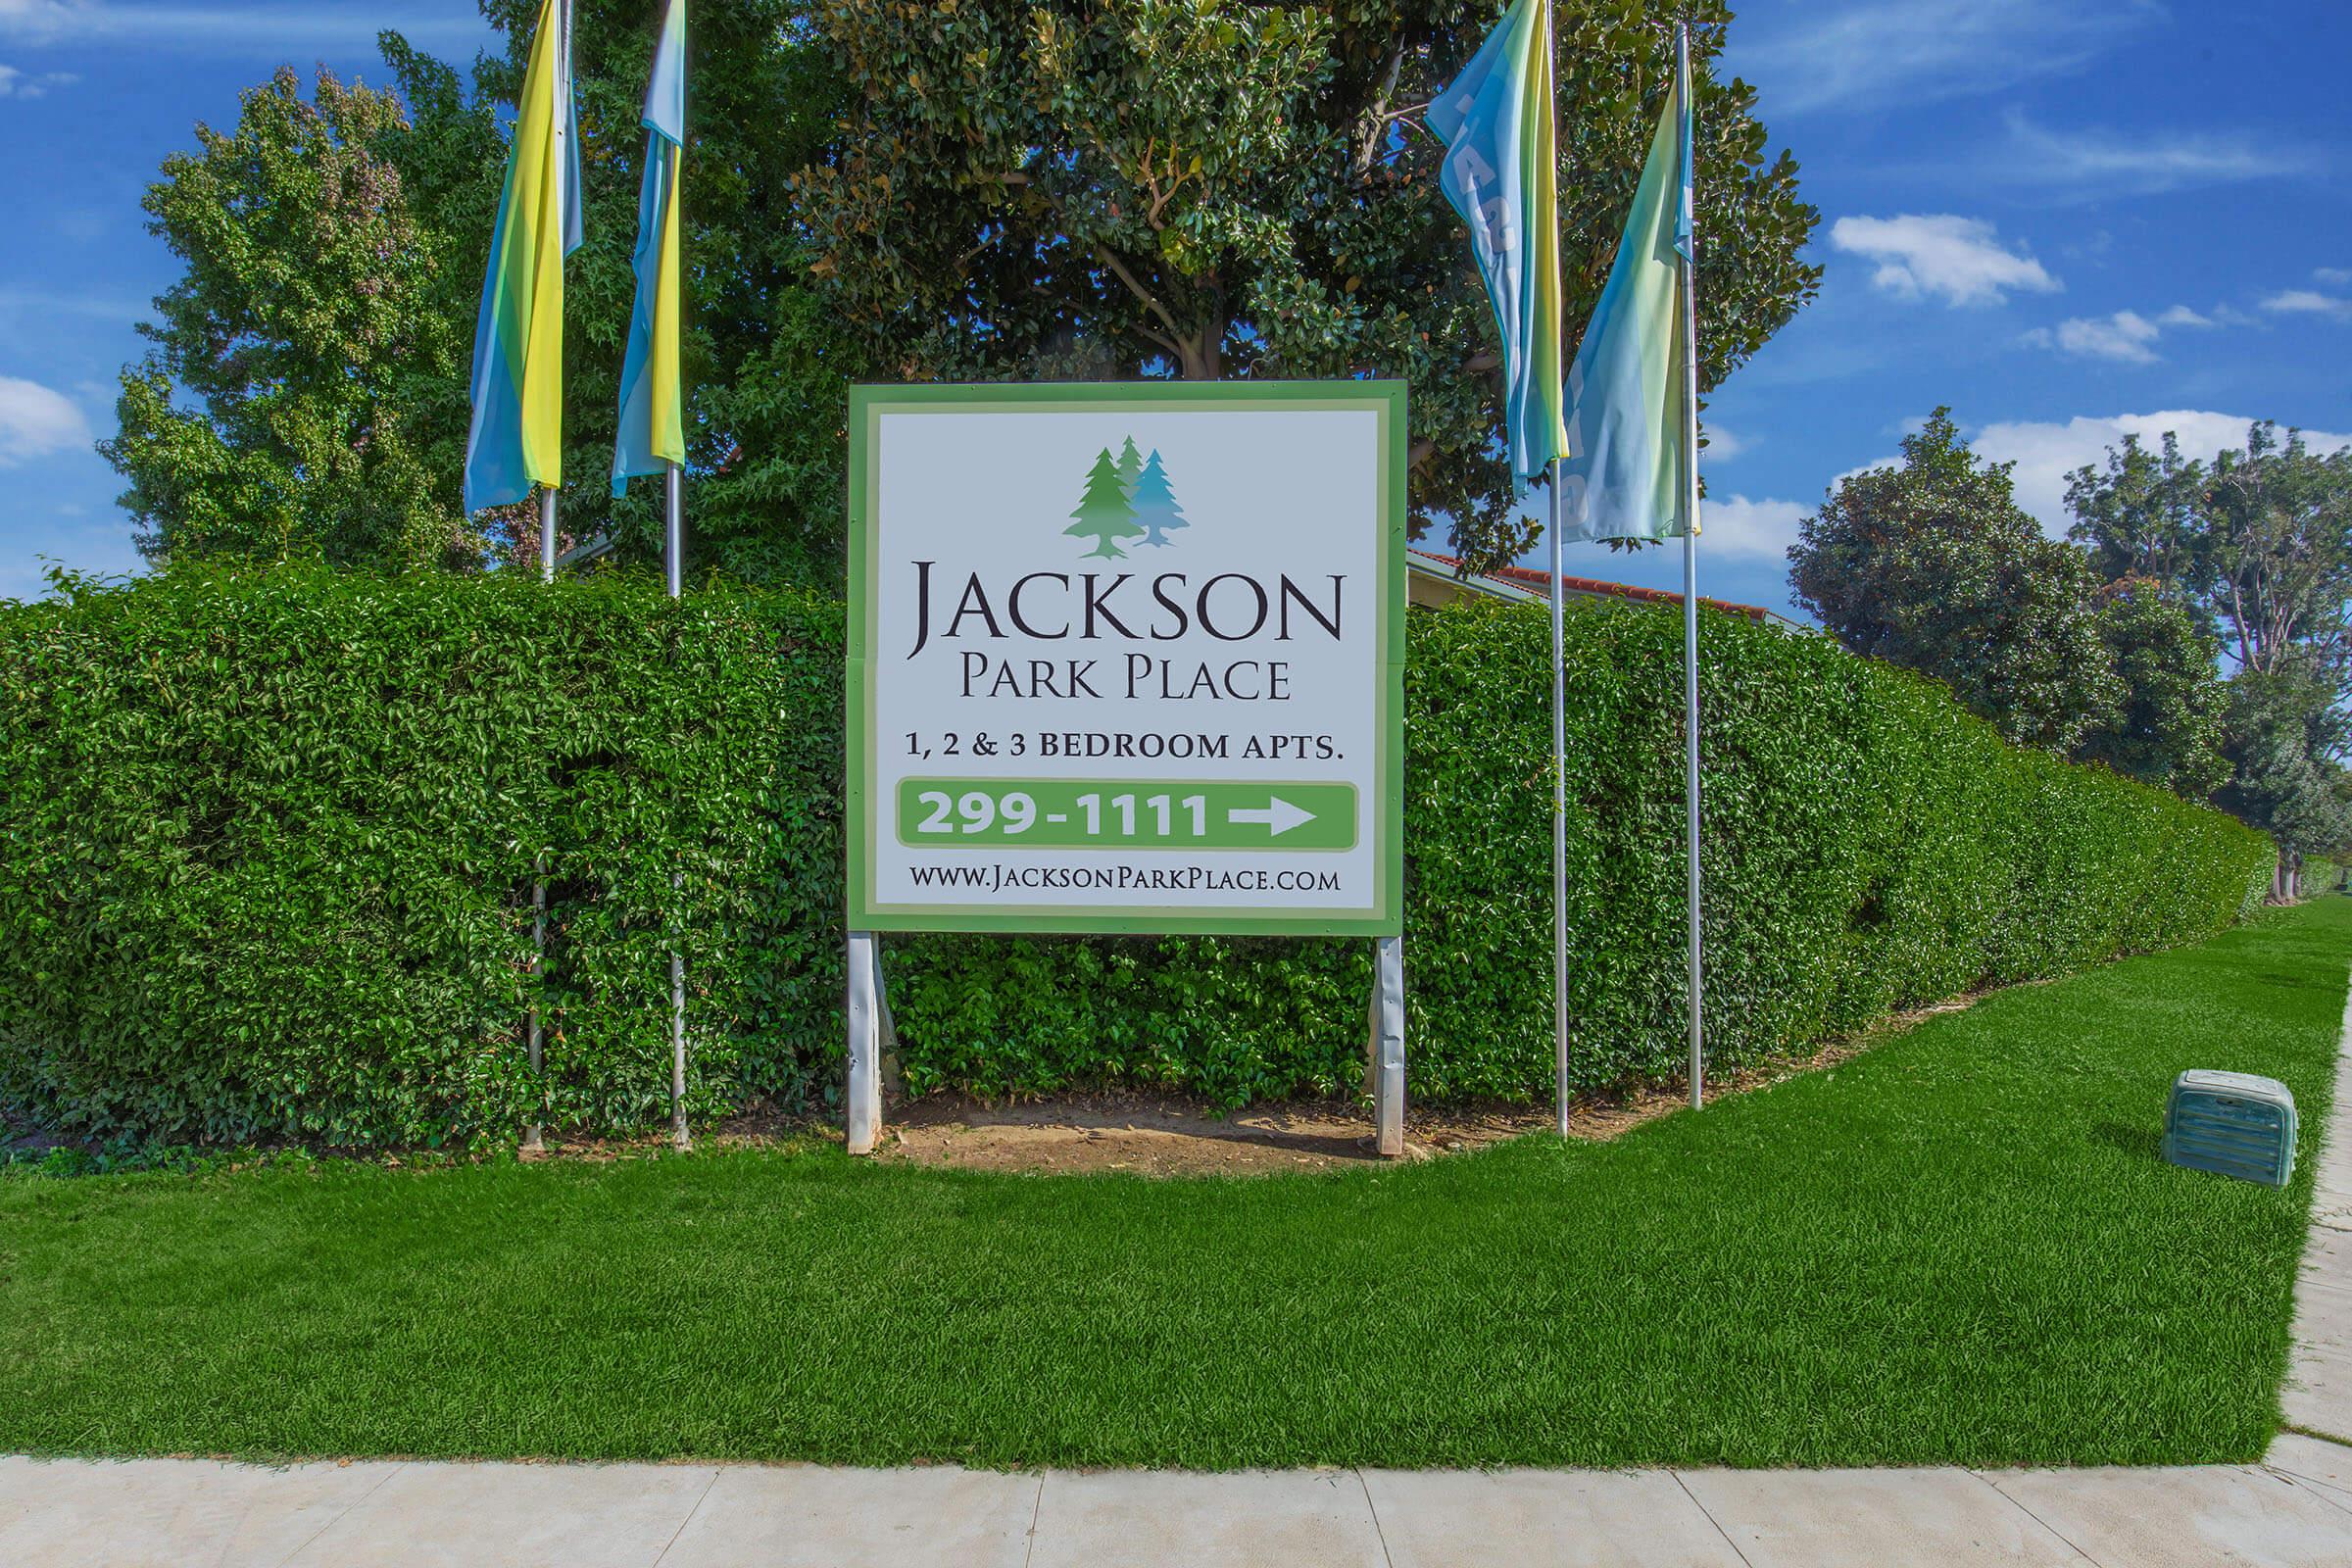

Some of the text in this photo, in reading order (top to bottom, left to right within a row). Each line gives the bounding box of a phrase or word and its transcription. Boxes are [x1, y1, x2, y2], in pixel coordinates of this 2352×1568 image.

[906, 561, 1348, 661] JACKSON
[959, 651, 1291, 701] PARK PLACE
[906, 731, 1345, 760] 1, 2 & 3 BEDROOM APTS.
[917, 791, 1205, 836] 299-1111
[909, 864, 1342, 894] WWW.JACKSONPARKPLACE.COM
